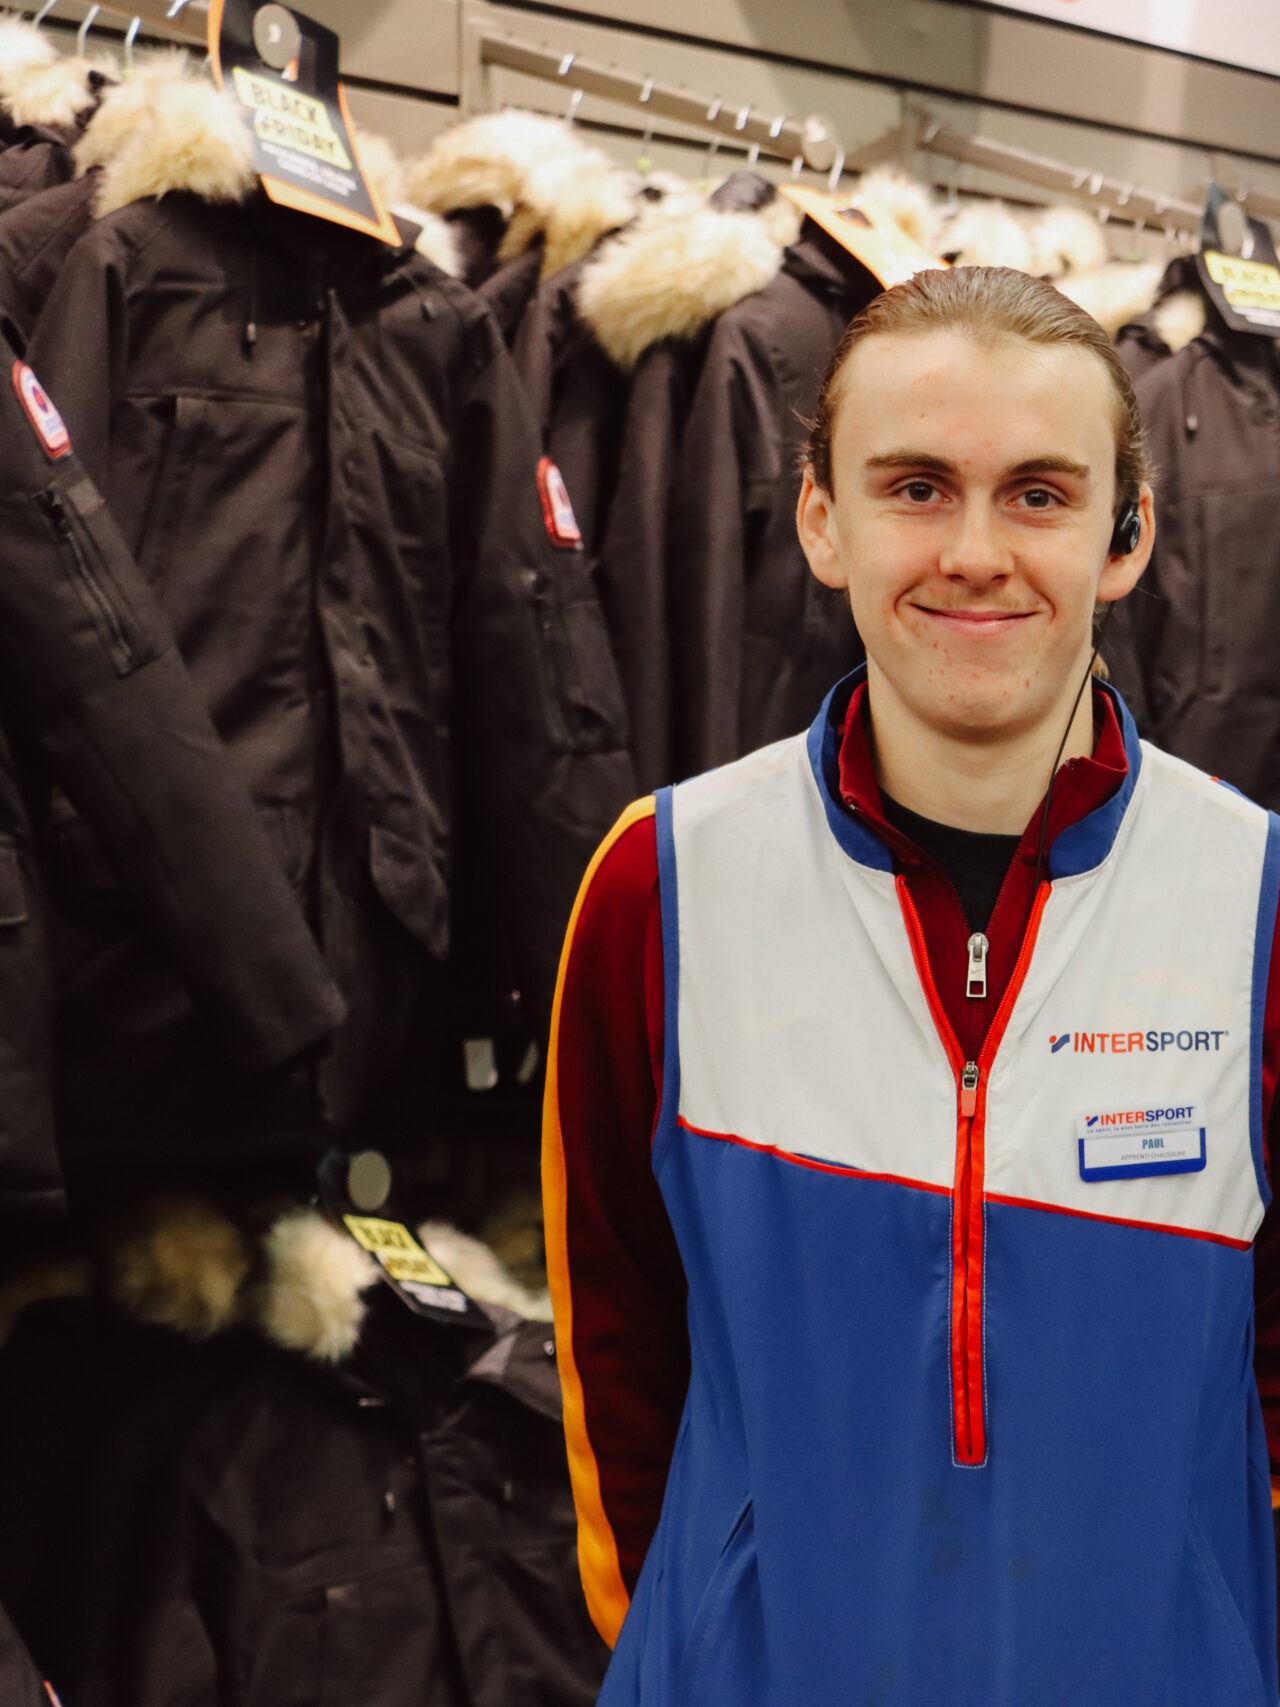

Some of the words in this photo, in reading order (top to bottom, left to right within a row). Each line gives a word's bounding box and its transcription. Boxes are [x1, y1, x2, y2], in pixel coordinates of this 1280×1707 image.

[251, 82, 317, 122] BLACK
[1074, 1030, 1225, 1053] INTERSPORT
[1101, 1106, 1193, 1126] INTERSPORT
[1142, 1138, 1165, 1149] PAUL
